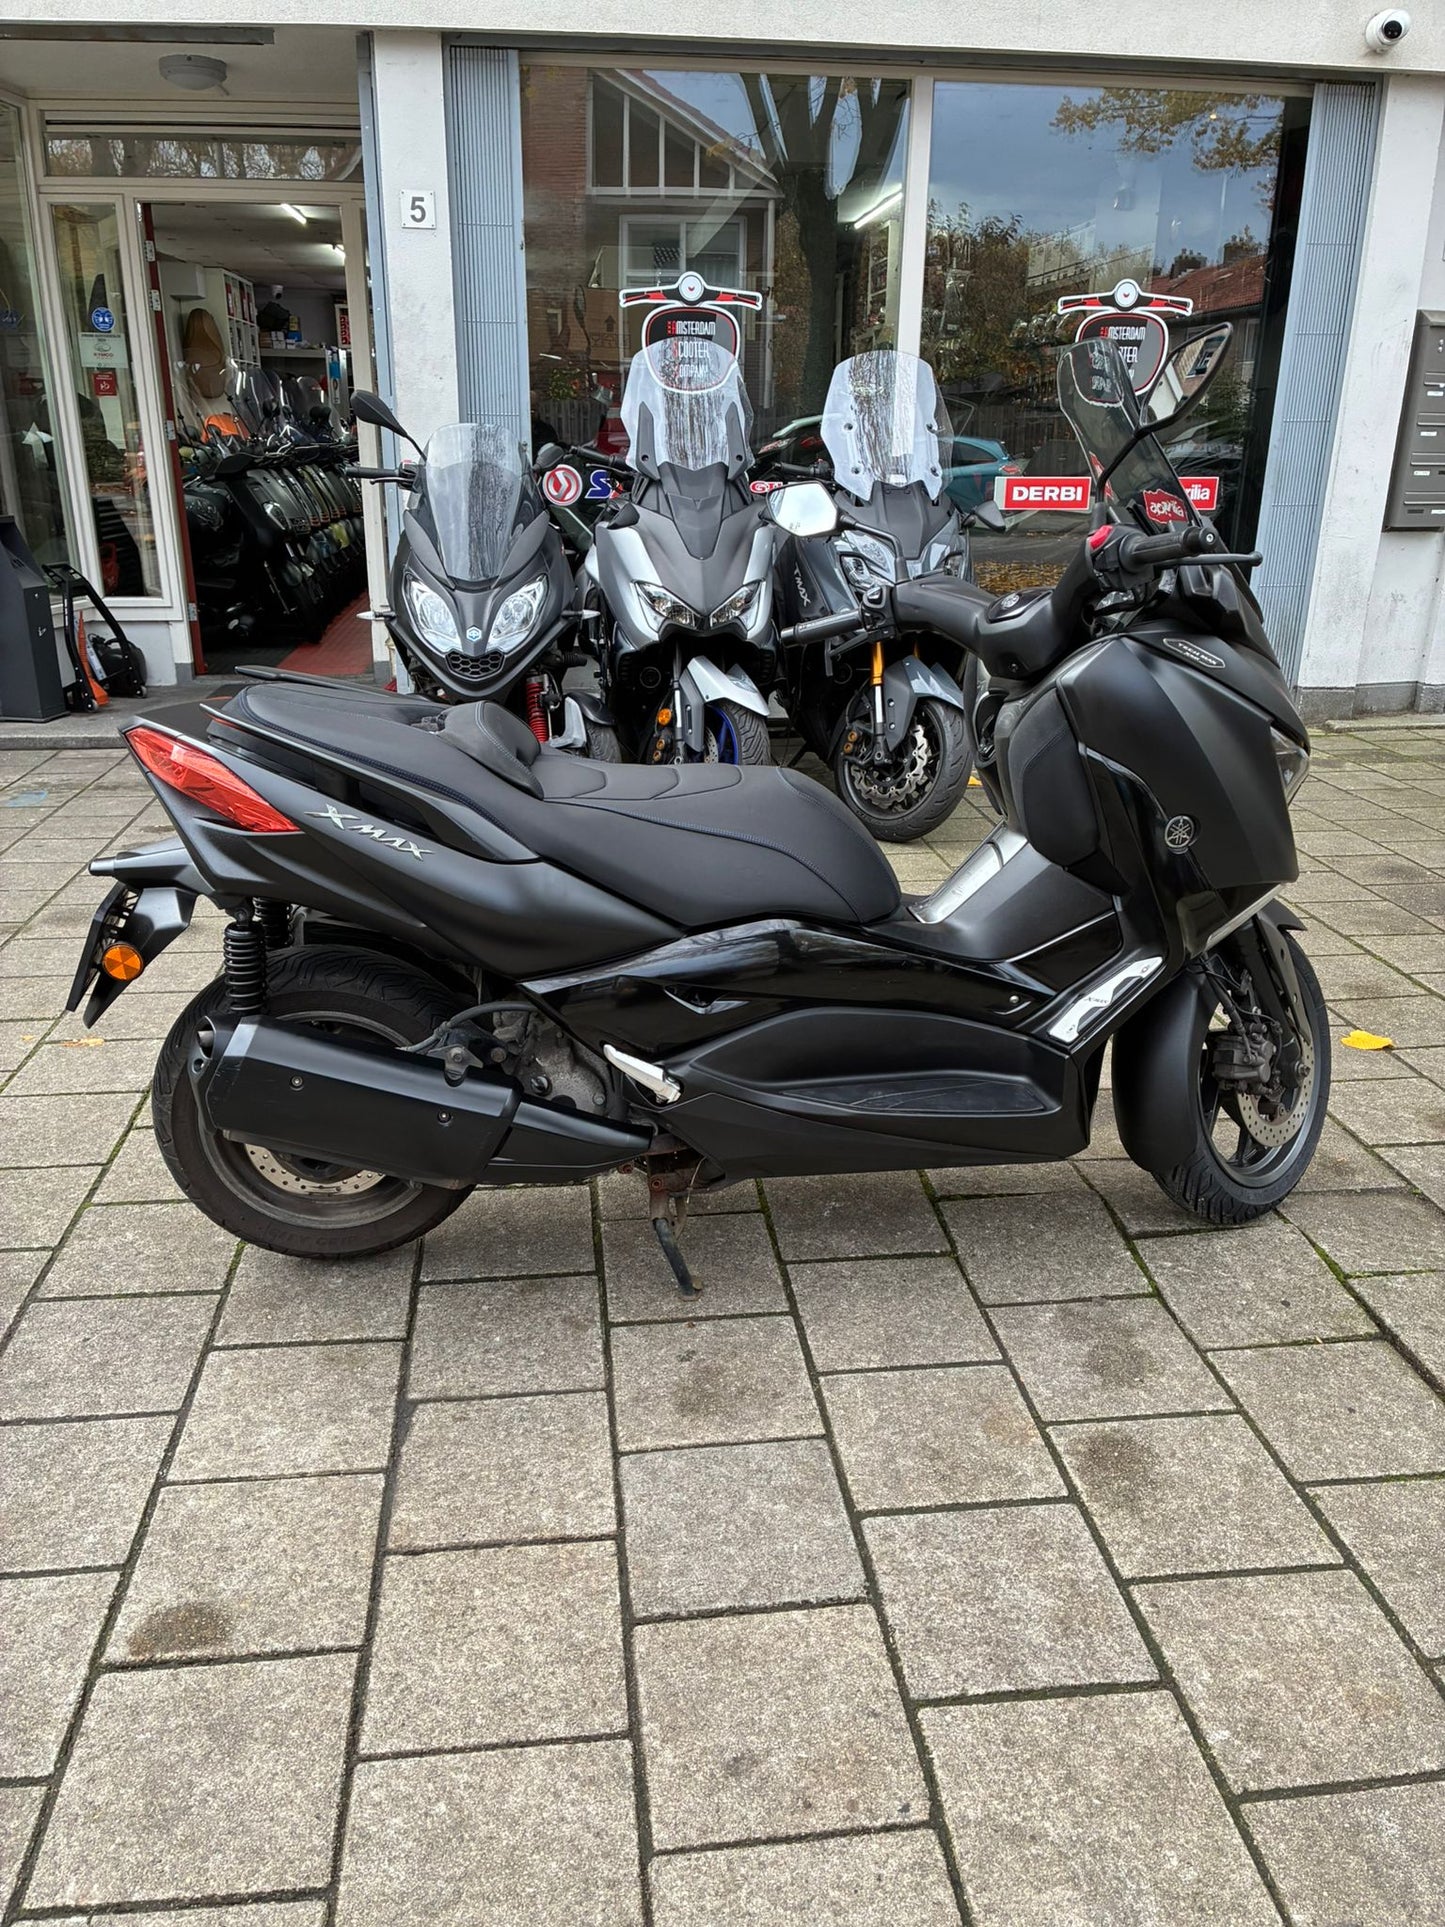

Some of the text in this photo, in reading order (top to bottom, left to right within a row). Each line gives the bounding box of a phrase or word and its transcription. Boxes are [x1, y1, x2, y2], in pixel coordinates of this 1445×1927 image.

[410, 196, 426, 223] 5
[671, 320, 716, 335] AMSTERDAM
[672, 341, 710, 359] SCOOTER
[1012, 486, 1083, 501] DERBI
